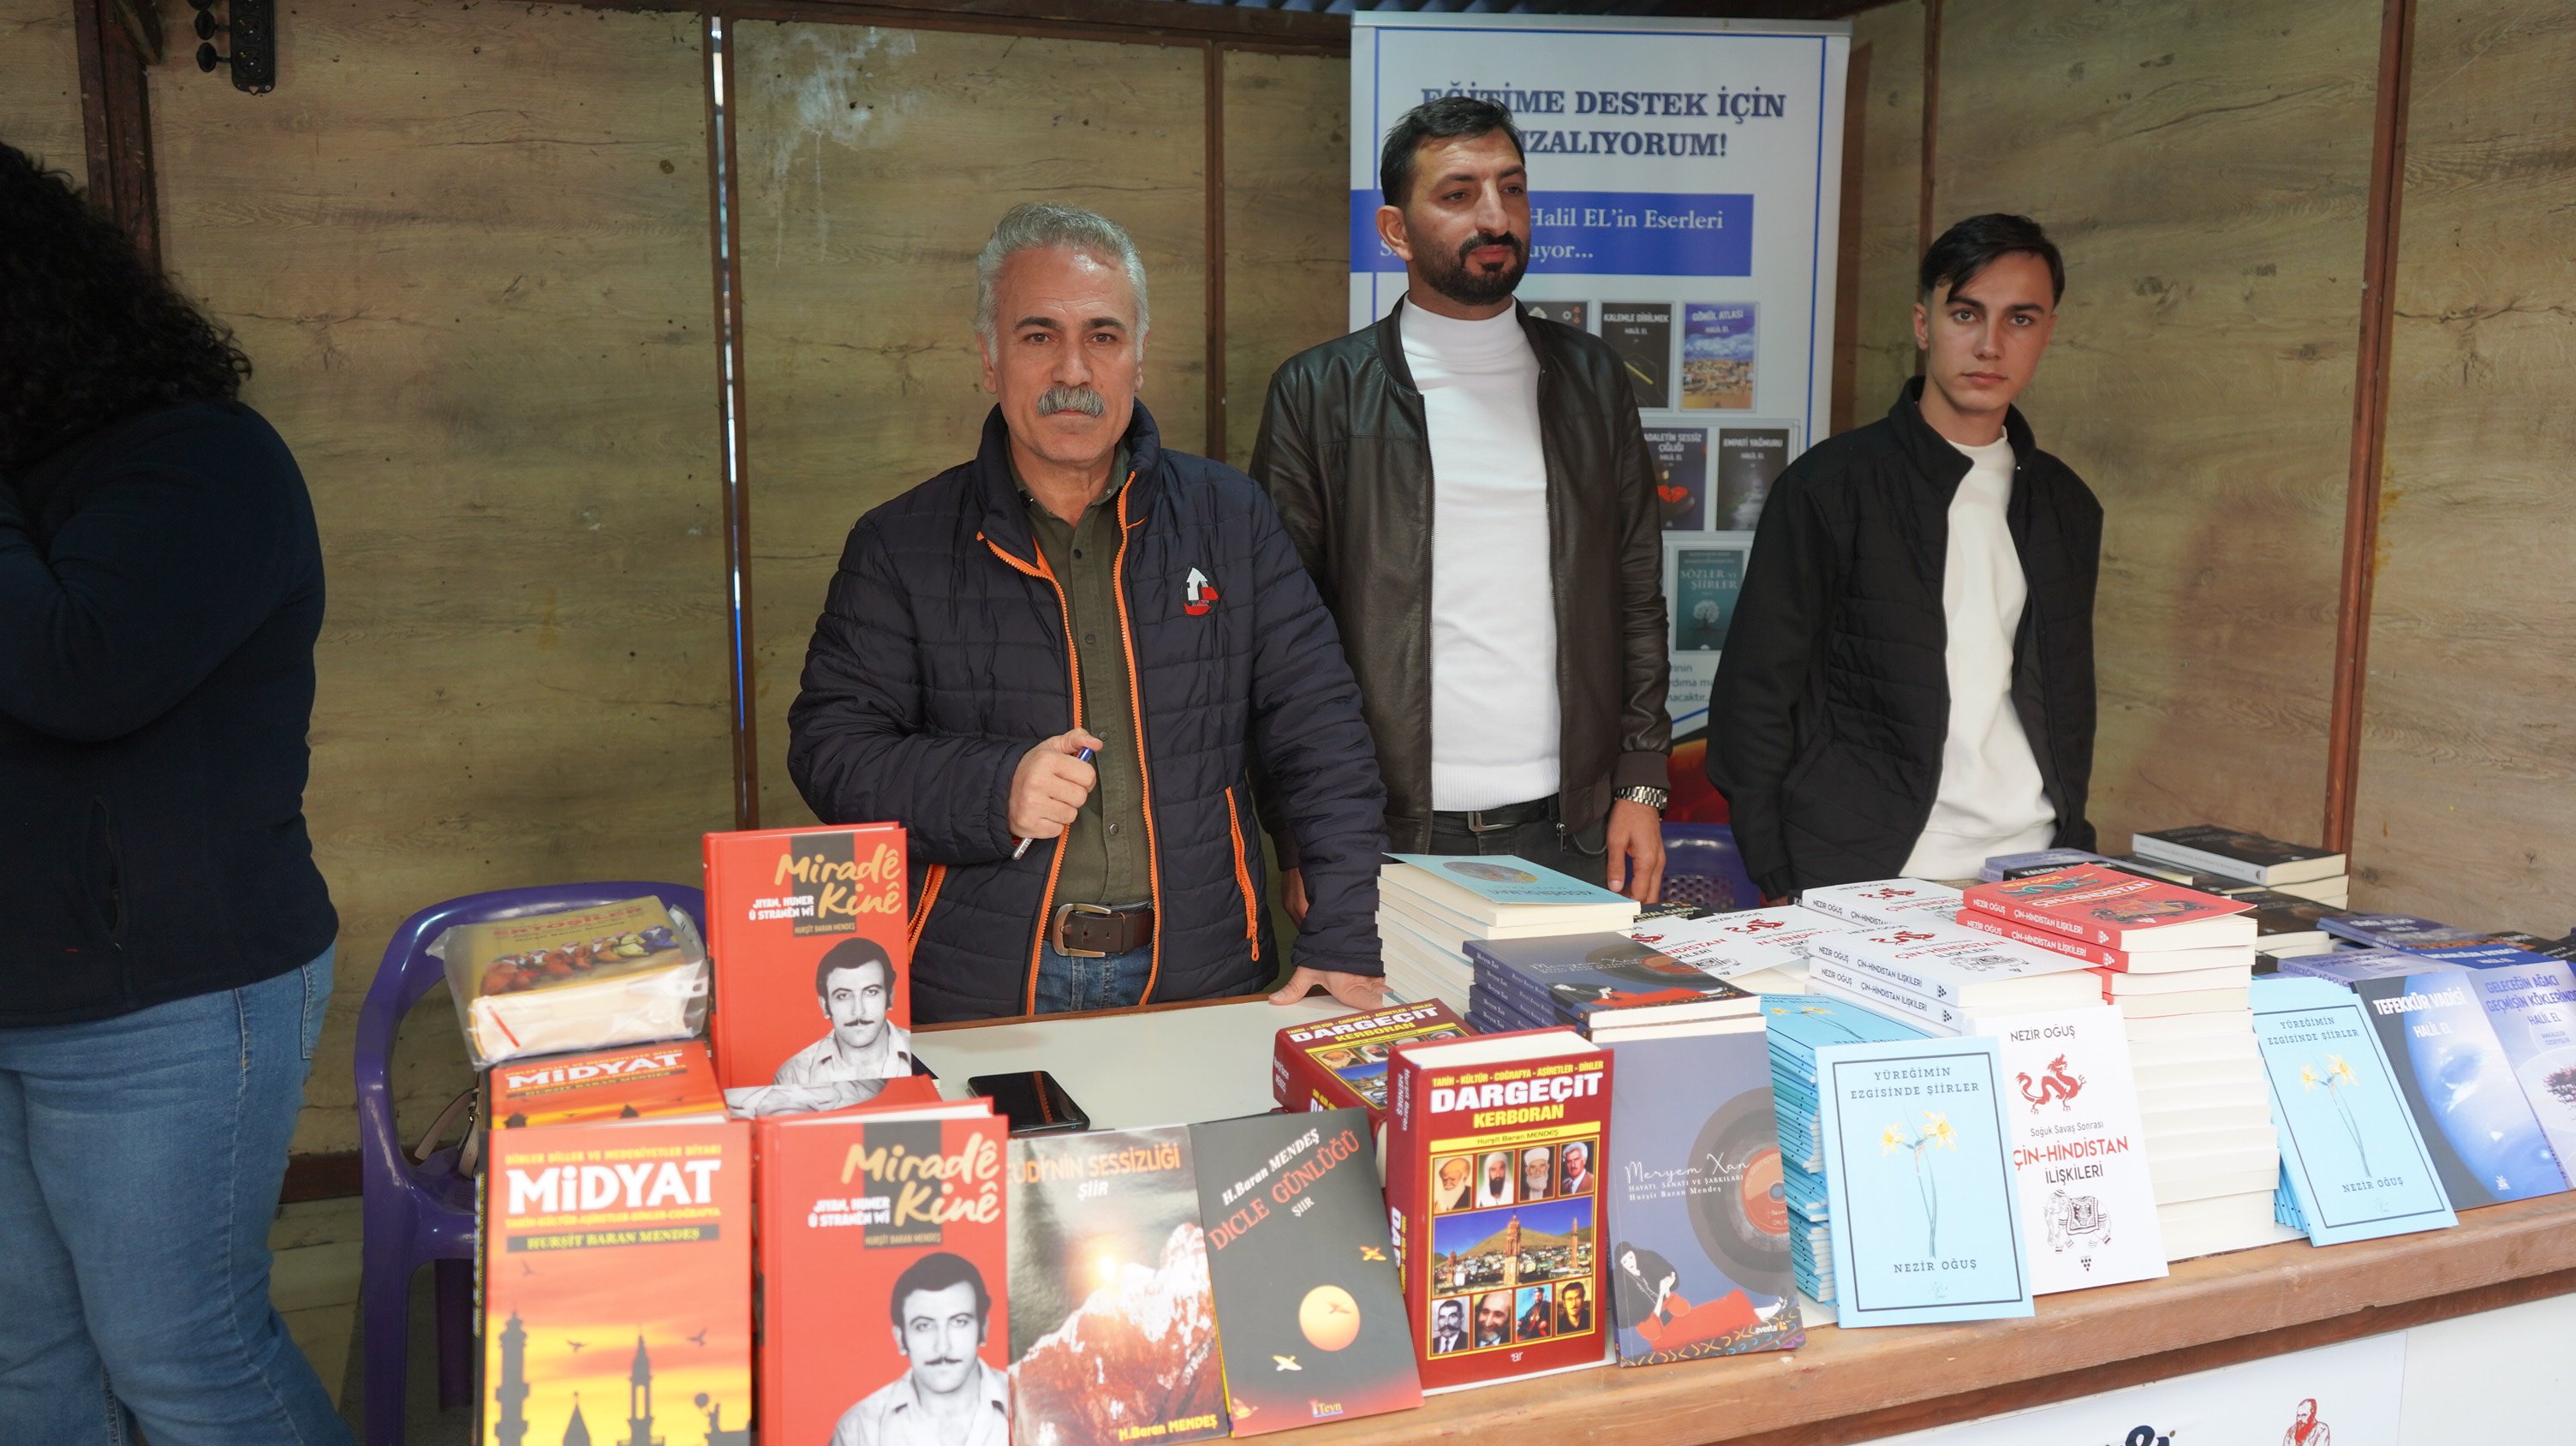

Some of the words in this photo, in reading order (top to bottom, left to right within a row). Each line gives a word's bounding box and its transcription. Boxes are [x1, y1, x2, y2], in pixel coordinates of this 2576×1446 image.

[1575, 89, 1708, 117] DESTEK
[1716, 86, 1786, 125] İÇİN
[1530, 208, 1577, 228] Halil
[1643, 210, 1723, 230] Eserleri
[774, 843, 901, 886] Miradê
[818, 882, 902, 918] Kinê
[2373, 991, 2430, 1016] TEFEKKÜR
[1334, 1022, 1416, 1042] KERBORAN
[2010, 1028, 2042, 1043] NEZİR
[2043, 1025, 2076, 1039] OĞUŞ
[2280, 1016, 2336, 1030] YÜREĞİMİN
[1432, 1076, 1455, 1088] TARİH
[1460, 1072, 1488, 1085] KÜLTÜR
[1494, 1068, 1532, 1082] COĞRAFYA
[1578, 1061, 1604, 1072] DİNLER
[1875, 1067, 1952, 1082] YÜREĞİMİN
[1850, 1084, 1922, 1100] EZGİSİNDE
[1927, 1081, 1980, 1096] ŞİİRLER
[1473, 1103, 1565, 1129] KERBORAN
[2030, 1126, 2054, 1138] Soğuk
[2054, 1123, 2076, 1134] Savaş
[2077, 1120, 2104, 1132] Sonrası
[840, 1131, 1000, 1185] Miradê
[1088, 1142, 1182, 1178] SESSİZLİĞİ
[1220, 1167, 1270, 1206] H.Baran
[1267, 1126, 1321, 1174] MENDEŞ
[2012, 1136, 2129, 1172] ÇİN-HİNDİSTAN
[1624, 1160, 1702, 1186] Meryem
[1706, 1151, 1751, 1175] Xan
[2045, 1160, 2104, 1186] İLİŞKİLERİ
[1208, 1197, 1272, 1252] DİCLE
[1271, 1128, 1362, 1205] GÜNLÜĞÜ
[1661, 1189, 1686, 1198] Baran
[2342, 1181, 2375, 1193] NEZİR
[2377, 1176, 2405, 1189] OĞUŞ
[893, 1180, 1001, 1228] Kinê
[1893, 1259, 1935, 1274] NEZİR
[1941, 1258, 1978, 1273] OĞUŞ
[1118, 1424, 1166, 1443] H.Baran
[1167, 1413, 1219, 1433] MENDEŞ
